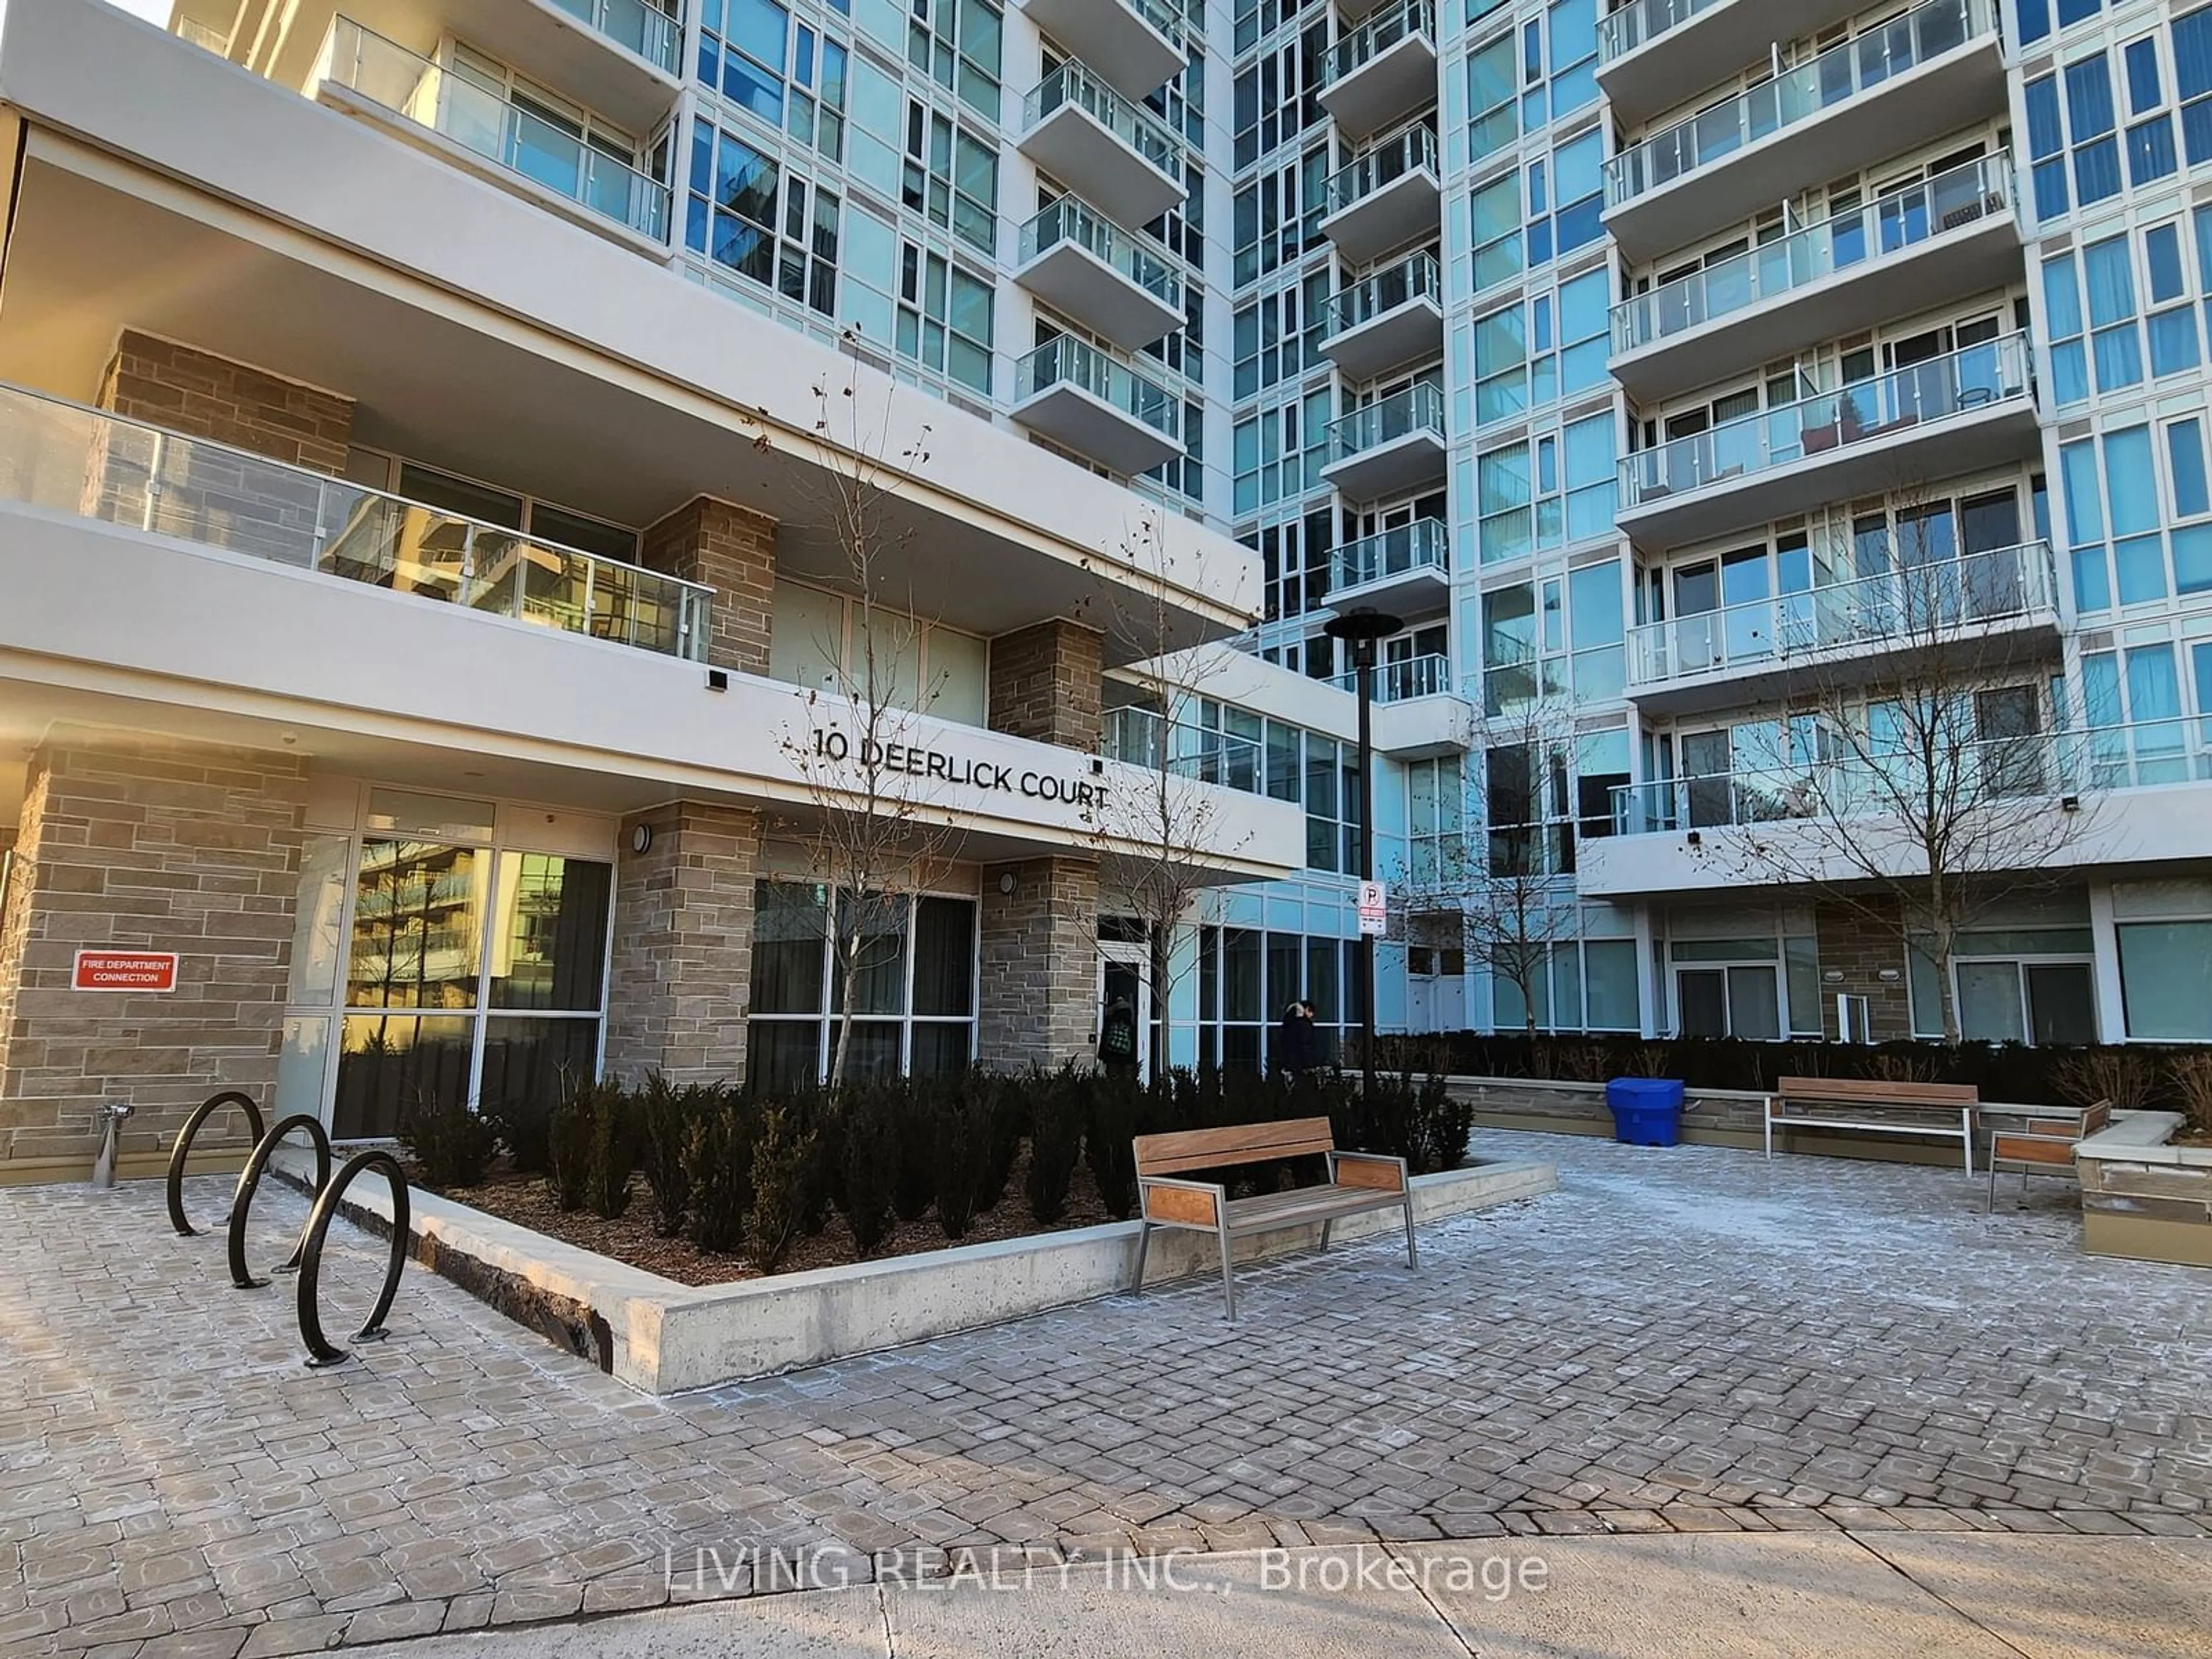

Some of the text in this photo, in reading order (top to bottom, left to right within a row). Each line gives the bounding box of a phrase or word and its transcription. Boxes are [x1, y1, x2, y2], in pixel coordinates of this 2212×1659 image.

[813, 729, 1109, 809] 10 DEERLICK COURT
[82, 960, 171, 971] FIRE DEPARTMENT
[93, 972, 159, 982] CONNECTION
